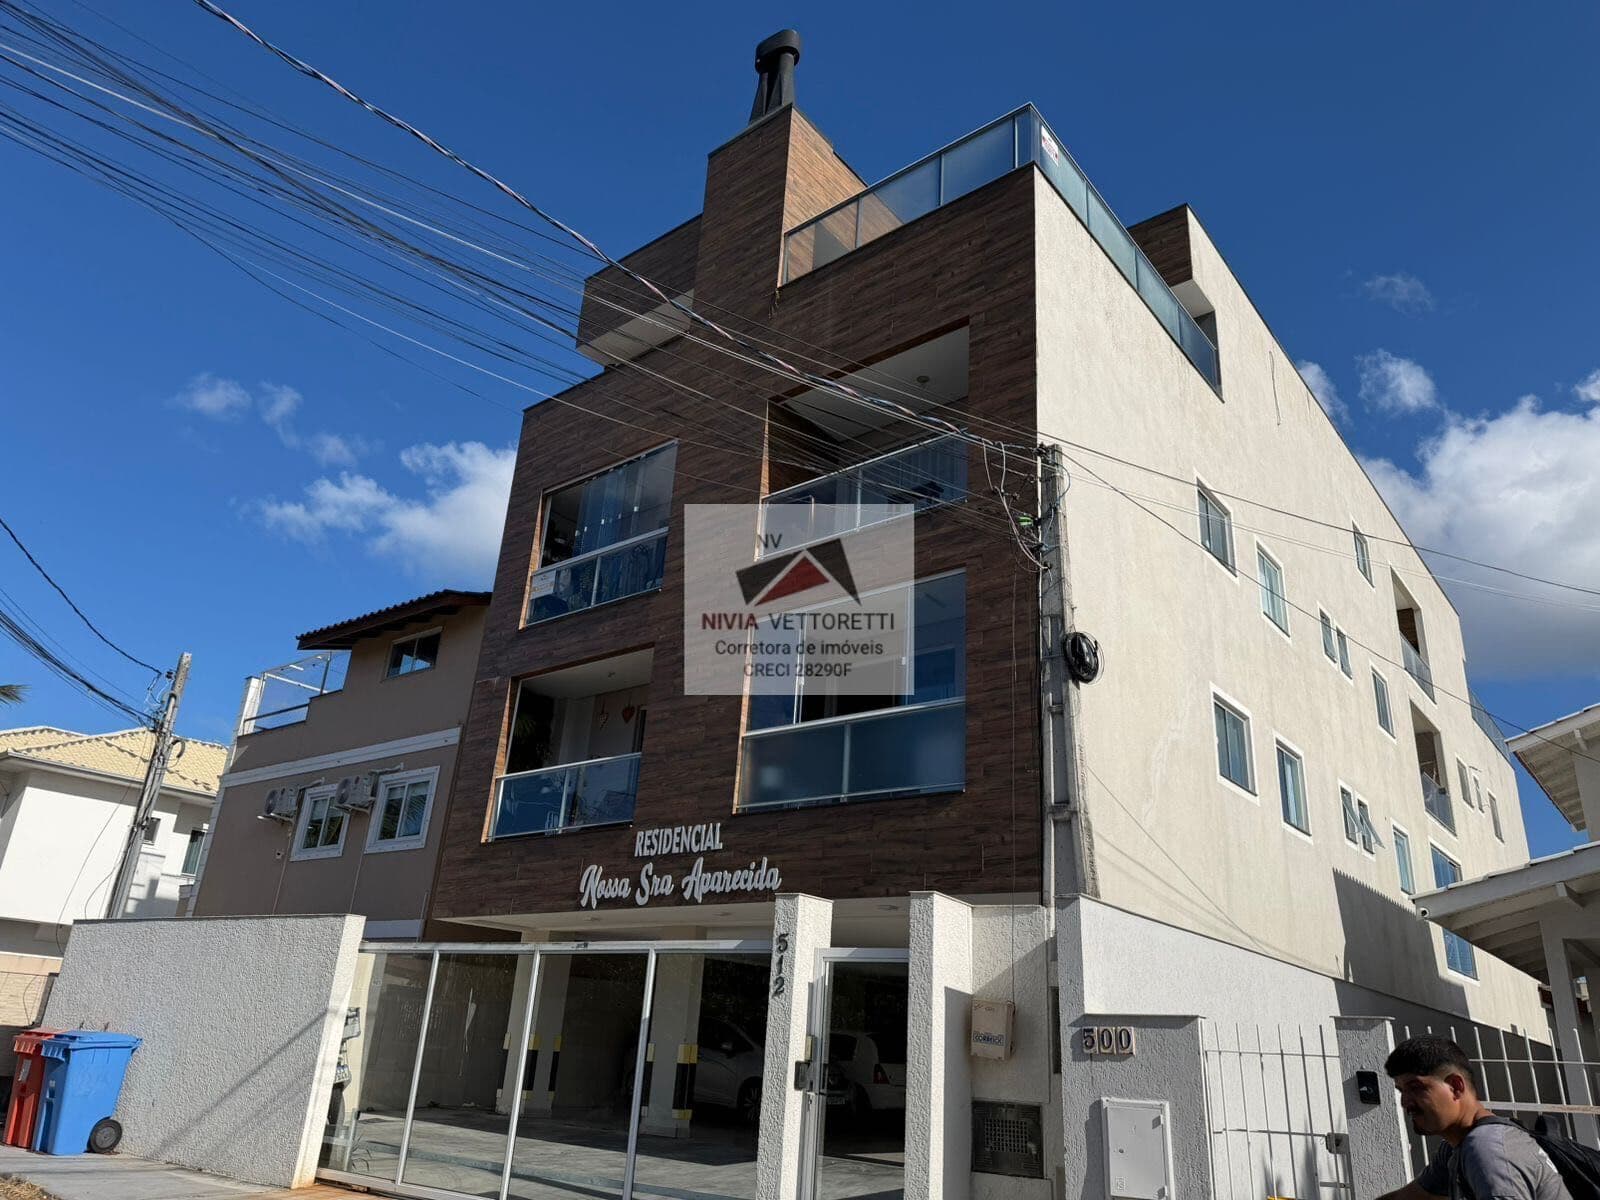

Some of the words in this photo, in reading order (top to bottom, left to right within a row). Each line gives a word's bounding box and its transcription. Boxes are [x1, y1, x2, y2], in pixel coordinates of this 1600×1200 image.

[634, 822, 723, 857] RESIDENCIAL
[580, 864, 631, 909] Nossa
[636, 862, 674, 906] Sra
[681, 857, 782, 903] Aparecida
[773, 933, 789, 999] 512
[1083, 1027, 1131, 1050] 500
